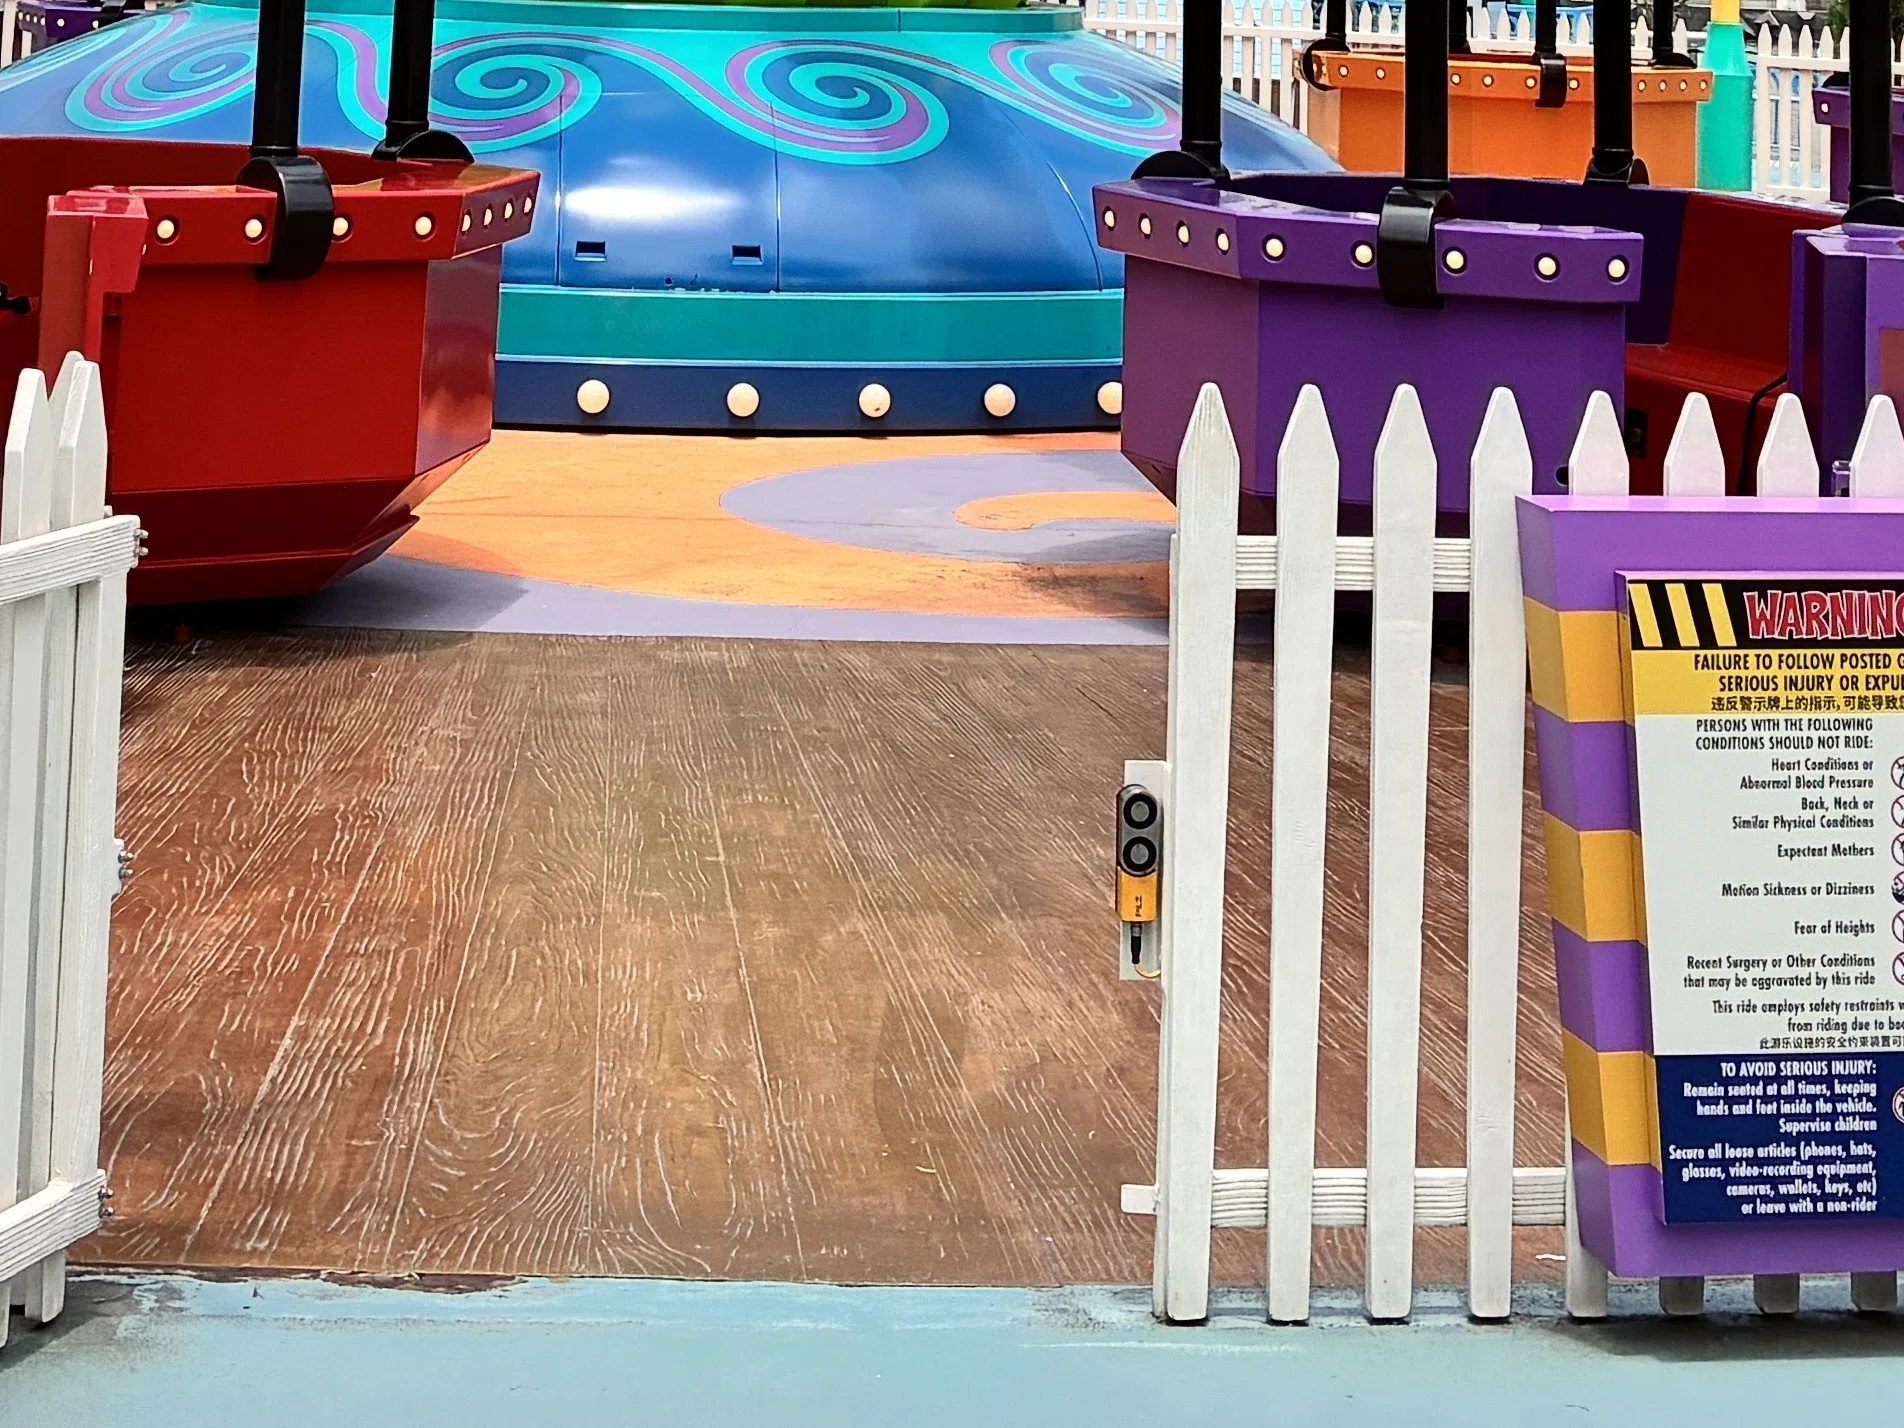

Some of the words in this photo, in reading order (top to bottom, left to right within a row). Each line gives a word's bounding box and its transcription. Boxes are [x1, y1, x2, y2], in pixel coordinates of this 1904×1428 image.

[1694, 653, 1749, 671] FAILURE
[1754, 653, 1772, 670] TO
[1778, 653, 1834, 670] FOLLOW
[1840, 652, 1892, 670] POSTED
[1719, 675, 1778, 692] SERIOUS
[1783, 675, 1834, 692] INJURY
[1840, 675, 1859, 691] OR
[1696, 718, 1747, 732] PERSONS
[1752, 718, 1779, 732] WITH
[1784, 718, 1803, 732] THE
[1808, 718, 1873, 731] FOLLOWING
[1696, 737, 1765, 750] CONDITIONS
[1769, 736, 1813, 750] SHOULD
[1818, 736, 1840, 749] NOT
[1845, 736, 1873, 749] RIDE:
[1771, 758, 1800, 772] Heart
[1805, 756, 1859, 771] Conditions
[1863, 760, 1873, 771] or
[1740, 775, 1791, 789] Abnormal
[1796, 775, 1825, 789] Blood
[1829, 774, 1873, 789] Pressure
[1801, 796, 1829, 812] Back,
[1834, 795, 1859, 810] Neck
[1863, 799, 1874, 810] or
[1732, 816, 1769, 829] Similar
[1774, 816, 1815, 832] Physical
[1820, 815, 1874, 828] Conditions
[1777, 844, 1827, 861] Expectant
[1831, 842, 1875, 857] Mothers
[1722, 883, 1759, 897] Motion
[1763, 882, 1807, 896] Sickness
[1811, 885, 1822, 896] or
[1826, 882, 1875, 895] Dizziness
[1794, 921, 1817, 935] Fear
[1821, 920, 1831, 934] of
[1836, 919, 1875, 937] Heights
[1687, 955, 1722, 969] Recent
[1726, 955, 1767, 972] Surgery
[1771, 958, 1782, 969] or
[1786, 954, 1816, 968] Other
[1820, 953, 1875, 967] Conditions
[1684, 975, 1704, 988] that
[1708, 977, 1730, 991] may
[1735, 973, 1747, 987] be
[1751, 972, 1812, 990] aggravated
[1815, 972, 1828, 989] by
[1832, 971, 1851, 986] this
[1854, 971, 1875, 985] ride
[1712, 1000, 1733, 1014] This
[1736, 999, 1757, 1013] ride
[1761, 998, 1805, 1016] employs
[1809, 997, 1841, 1015] safety
[1844, 997, 1894, 1012] restraints
[1787, 1017, 1813, 1032] from
[1816, 1017, 1848, 1034] riding
[1851, 1016, 1870, 1031] due
[1874, 1019, 1885, 1030] to
[1720, 1062, 1736, 1078] TO
[1739, 1061, 1776, 1077] AVOID
[1780, 1060, 1828, 1076] SERIOUS
[1832, 1059, 1877, 1075] INJURY:
[1683, 1082, 1724, 1097] Remain
[1728, 1081, 1763, 1096] seated
[1766, 1083, 1778, 1096] at
[1780, 1080, 1795, 1096] all
[1798, 1080, 1831, 1097] times,
[1834, 1079, 1877, 1097] keeping
[1696, 1100, 1729, 1116] hands
[1732, 1099, 1753, 1115] and
[1756, 1099, 1777, 1115] feet
[1780, 1099, 1812, 1114] inside
[1815, 1098, 1833, 1114] the
[1835, 1097, 1877, 1113] vehicle.
[1778, 1117, 1832, 1136] Supervise
[1834, 1115, 1878, 1132] children
[1668, 1144, 1705, 1160] Secure
[1708, 1143, 1722, 1159] all
[1725, 1143, 1754, 1159] loose
[1757, 1142, 1796, 1158] articles
[1800, 1141, 1846, 1160] (phones,
[1849, 1140, 1876, 1158] hats,
[1682, 1163, 1726, 1182] glasses,
[1729, 1161, 1814, 1179] video-recording
[1817, 1161, 1876, 1178] equipment,
[1726, 1181, 1775, 1197] cameras,
[1778, 1178, 1821, 1197] wallets,
[1825, 1178, 1853, 1197] keys,
[1857, 1178, 1877, 1196] etc)
[1741, 1202, 1754, 1214] or
[1756, 1199, 1786, 1214] leave
[1789, 1197, 1814, 1213] with
[1817, 1201, 1824, 1212] a
[1827, 1197, 1877, 1213] non-rider
